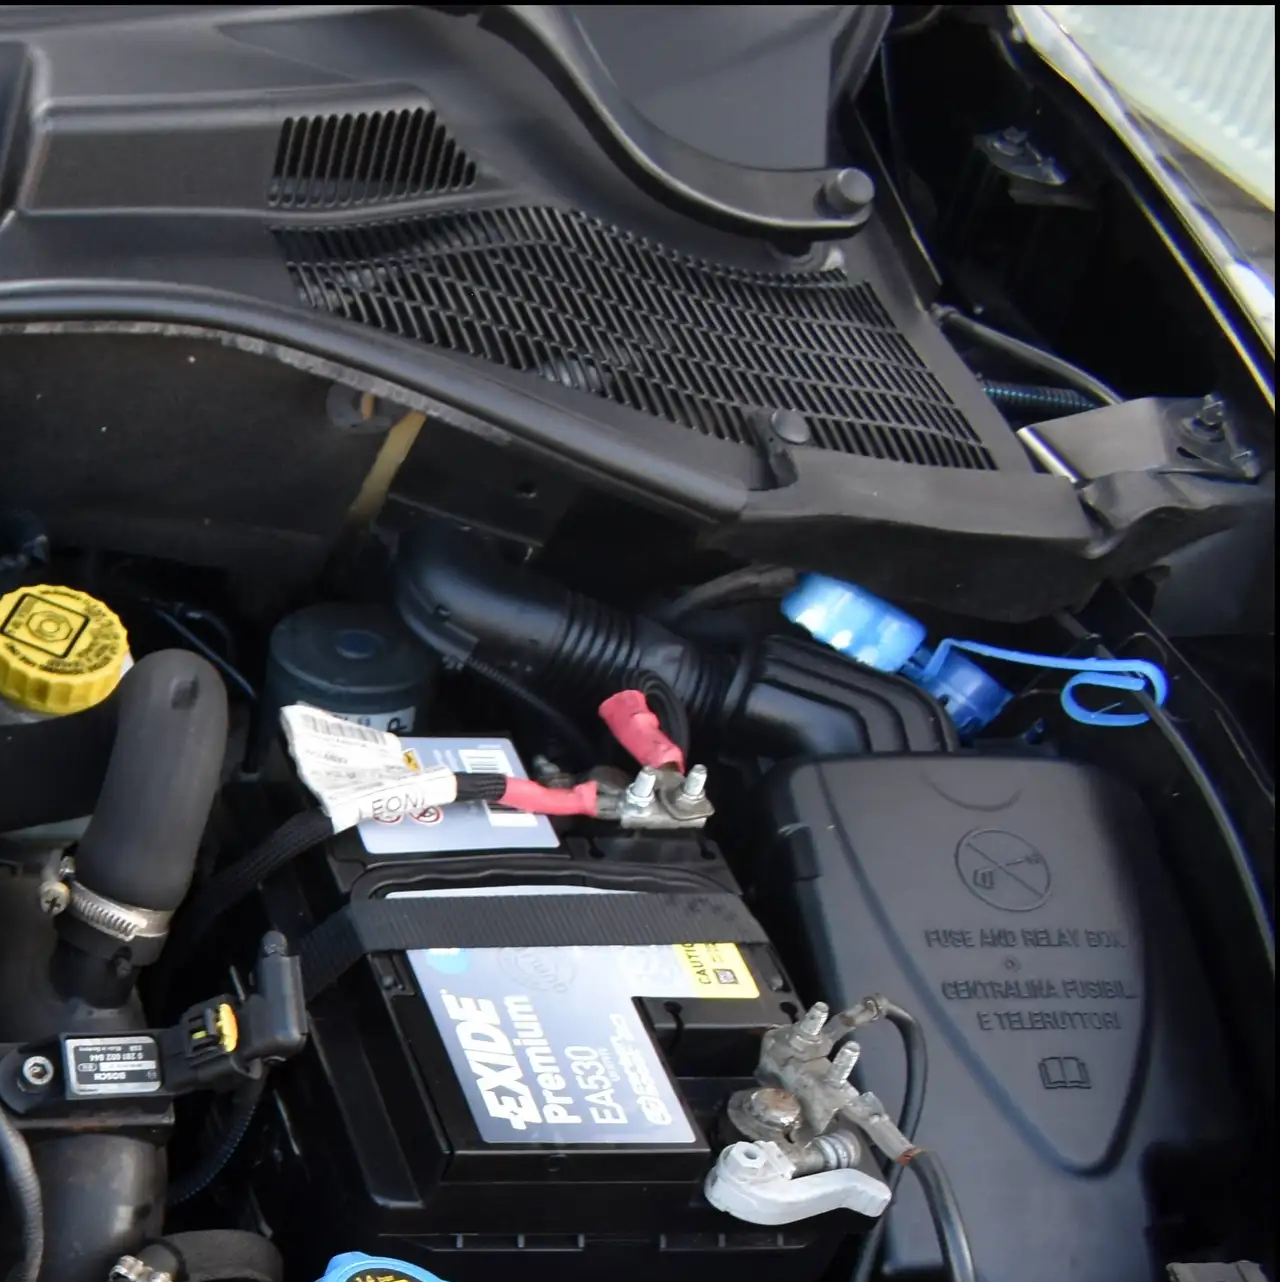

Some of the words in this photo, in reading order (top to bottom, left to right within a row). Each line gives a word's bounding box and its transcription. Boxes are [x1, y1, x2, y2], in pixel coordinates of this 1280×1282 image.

[924, 929, 975, 948] FUSE
[980, 928, 1017, 948] AND
[1021, 928, 1080, 948] RELAY
[94, 1071, 126, 1080] BOSCH
[443, 993, 542, 1130] EXIDE
[504, 995, 583, 1124] Premium
[564, 1046, 628, 1125] EA530
